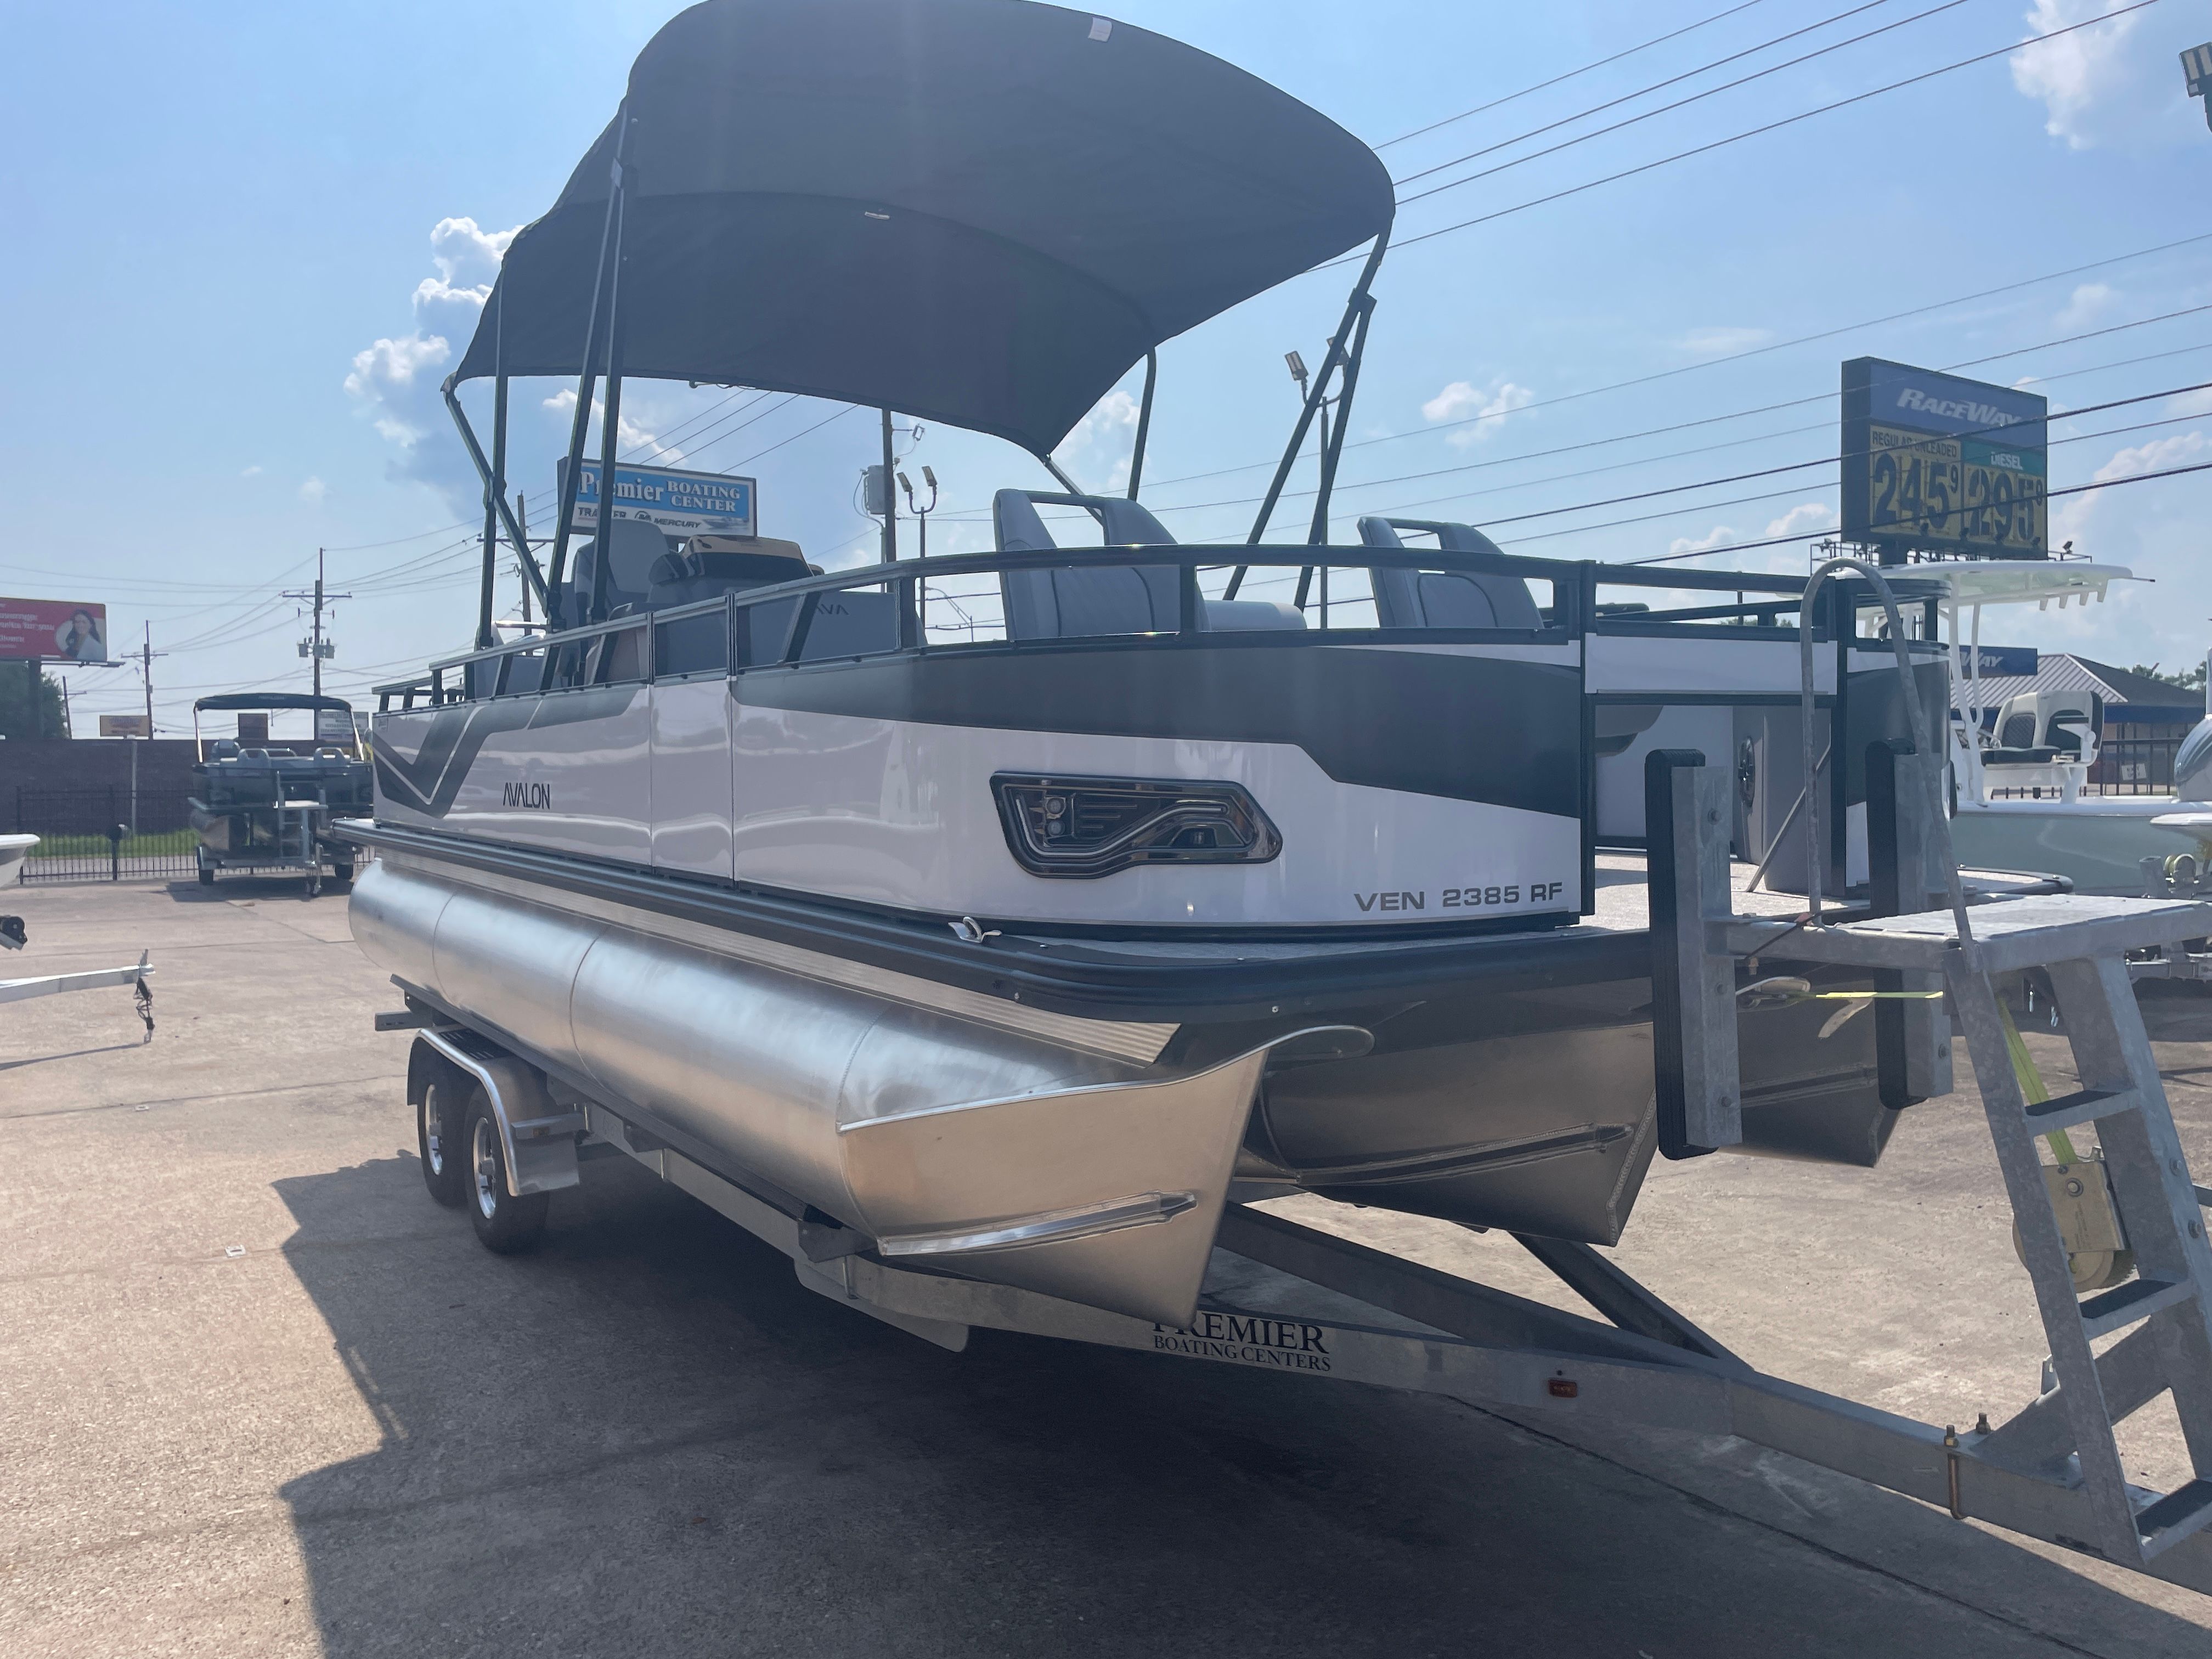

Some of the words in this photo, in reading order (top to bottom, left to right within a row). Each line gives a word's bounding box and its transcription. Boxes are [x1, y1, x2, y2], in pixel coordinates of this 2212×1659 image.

[1897, 387, 2023, 426] RACEWAY
[1991, 452, 2023, 470] DIESEL
[579, 472, 664, 501] Prmier
[667, 480, 741, 499] BOATING
[578, 507, 627, 518] TRAER
[671, 495, 736, 512] CENTER
[654, 518, 702, 528] MERCURY
[503, 782, 550, 809] AVALON
[1354, 891, 1425, 911] VEN
[1443, 885, 1520, 907] 2385
[1531, 882, 1562, 902] RF
[1153, 1312, 1329, 1354] EMIER
[1154, 1335, 1238, 1359] BOATING
[1241, 1346, 1331, 1372] CENTERS
